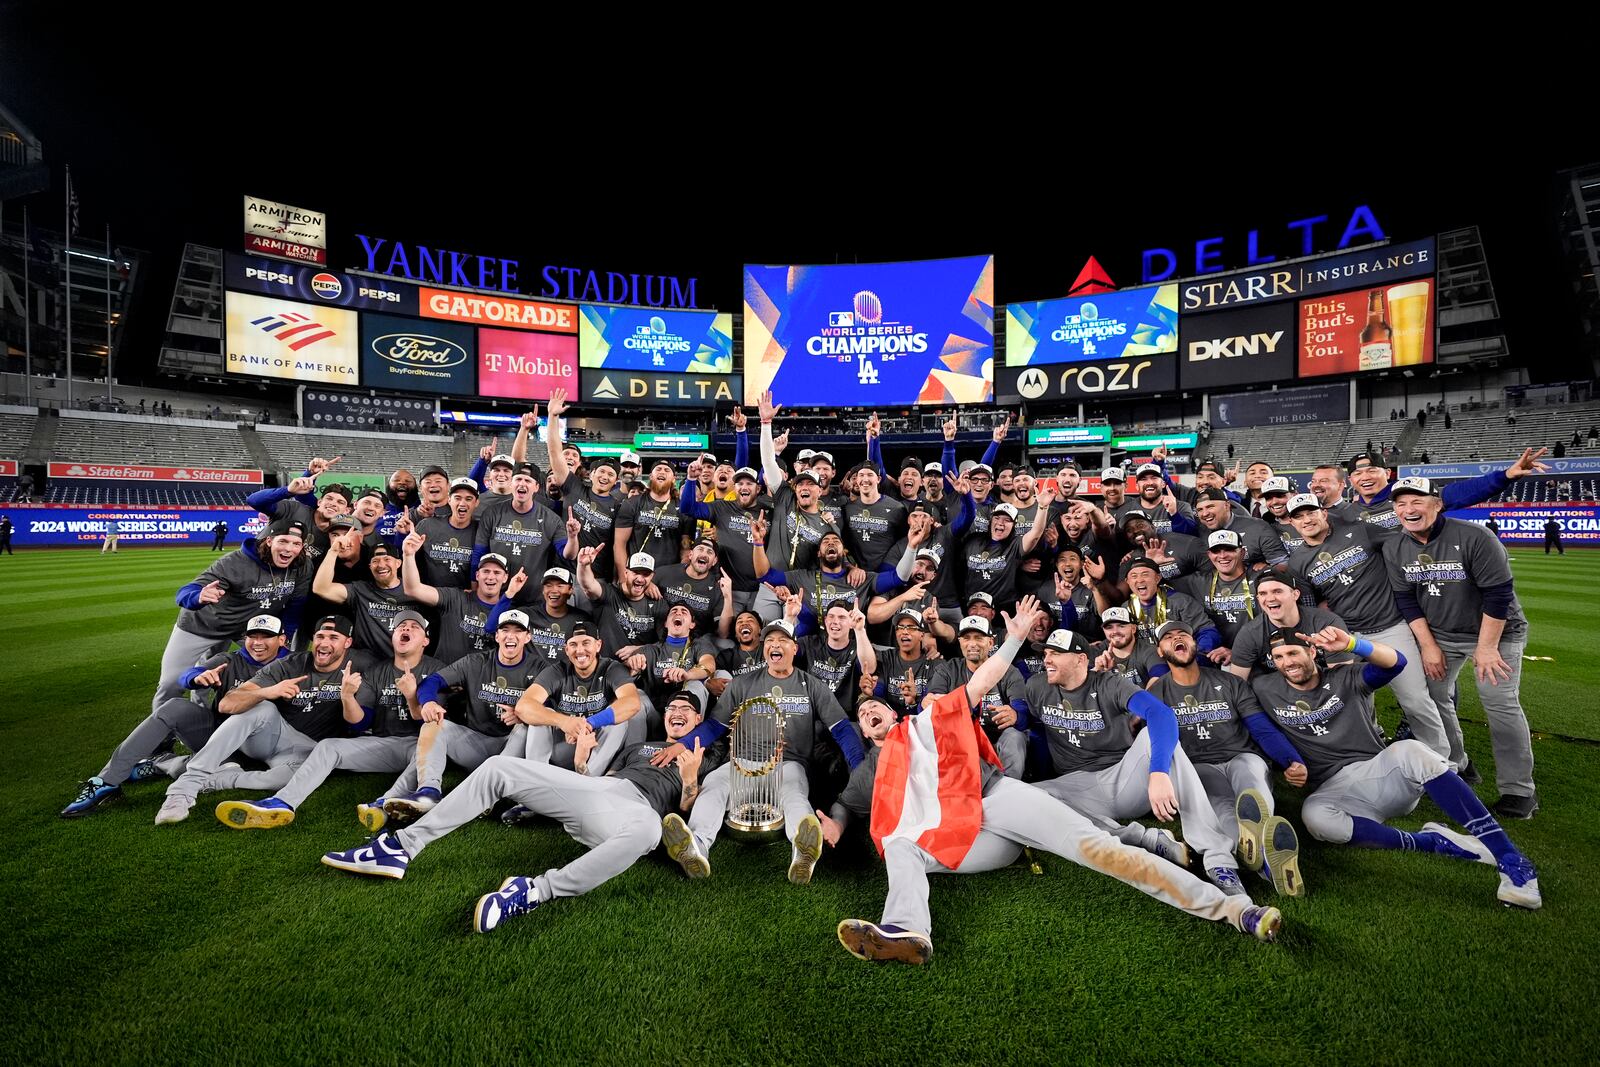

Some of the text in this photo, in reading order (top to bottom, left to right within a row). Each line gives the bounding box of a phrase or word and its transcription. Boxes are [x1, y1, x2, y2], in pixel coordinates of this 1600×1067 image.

[248, 203, 322, 226] ARMITRON
[253, 237, 318, 256] ARMITRON
[1142, 204, 1386, 282] DELTA
[246, 268, 294, 285] PEPSI
[356, 234, 698, 308] YANKEE STADIUM
[314, 282, 340, 291] PEPSI
[1184, 250, 1429, 310] STARR INSURANCE
[359, 288, 400, 302] PEPSI
[430, 294, 570, 328] GATORADE
[1304, 300, 1346, 316] This
[821, 326, 913, 336] WORLD SERIES
[1052, 323, 1127, 342] CHAMPIONS
[1305, 331, 1335, 344] For
[390, 336, 452, 364] Ford
[624, 338, 690, 352] CHAMPIONS
[806, 333, 928, 355] CHAMPIONS
[1188, 330, 1284, 362] DKNY
[1304, 345, 1344, 358] You.
[230, 354, 354, 374] BANK OF AMERICA
[507, 355, 572, 377] Mobile
[390, 366, 451, 378] BuyFordNow.com
[1060, 361, 1152, 394] razr
[630, 378, 733, 400] DELTA
[1292, 413, 1318, 422] BOSS
[30, 521, 158, 532] 2024 WORL SERIES
[495, 527, 542, 538] WORLD SERIES
[583, 520, 591, 532] LA
[654, 526, 662, 538] LA
[862, 529, 870, 541] LA
[432, 544, 458, 552] WORLD
[512, 543, 521, 556] LA
[450, 561, 458, 572] LA
[1308, 546, 1363, 578] WORLD SERIES
[1428, 562, 1463, 570] SERIES
[982, 570, 990, 580] LA
[1338, 572, 1353, 586] LA
[666, 587, 710, 604] WORLD SERIES
[1428, 581, 1442, 596] LA
[368, 602, 396, 610] WORLD
[1224, 610, 1237, 623] LA
[533, 628, 554, 637] WORLD
[474, 636, 483, 649] LA
[548, 645, 557, 658] LA
[814, 660, 836, 672] WORLD
[1042, 706, 1102, 720] WORLD SERIES
[1198, 702, 1229, 712] SERIES
[1042, 714, 1105, 731] CHAMPIONS
[1196, 723, 1211, 739] LA
[1308, 724, 1330, 736] LA
[1067, 730, 1080, 747] LA
